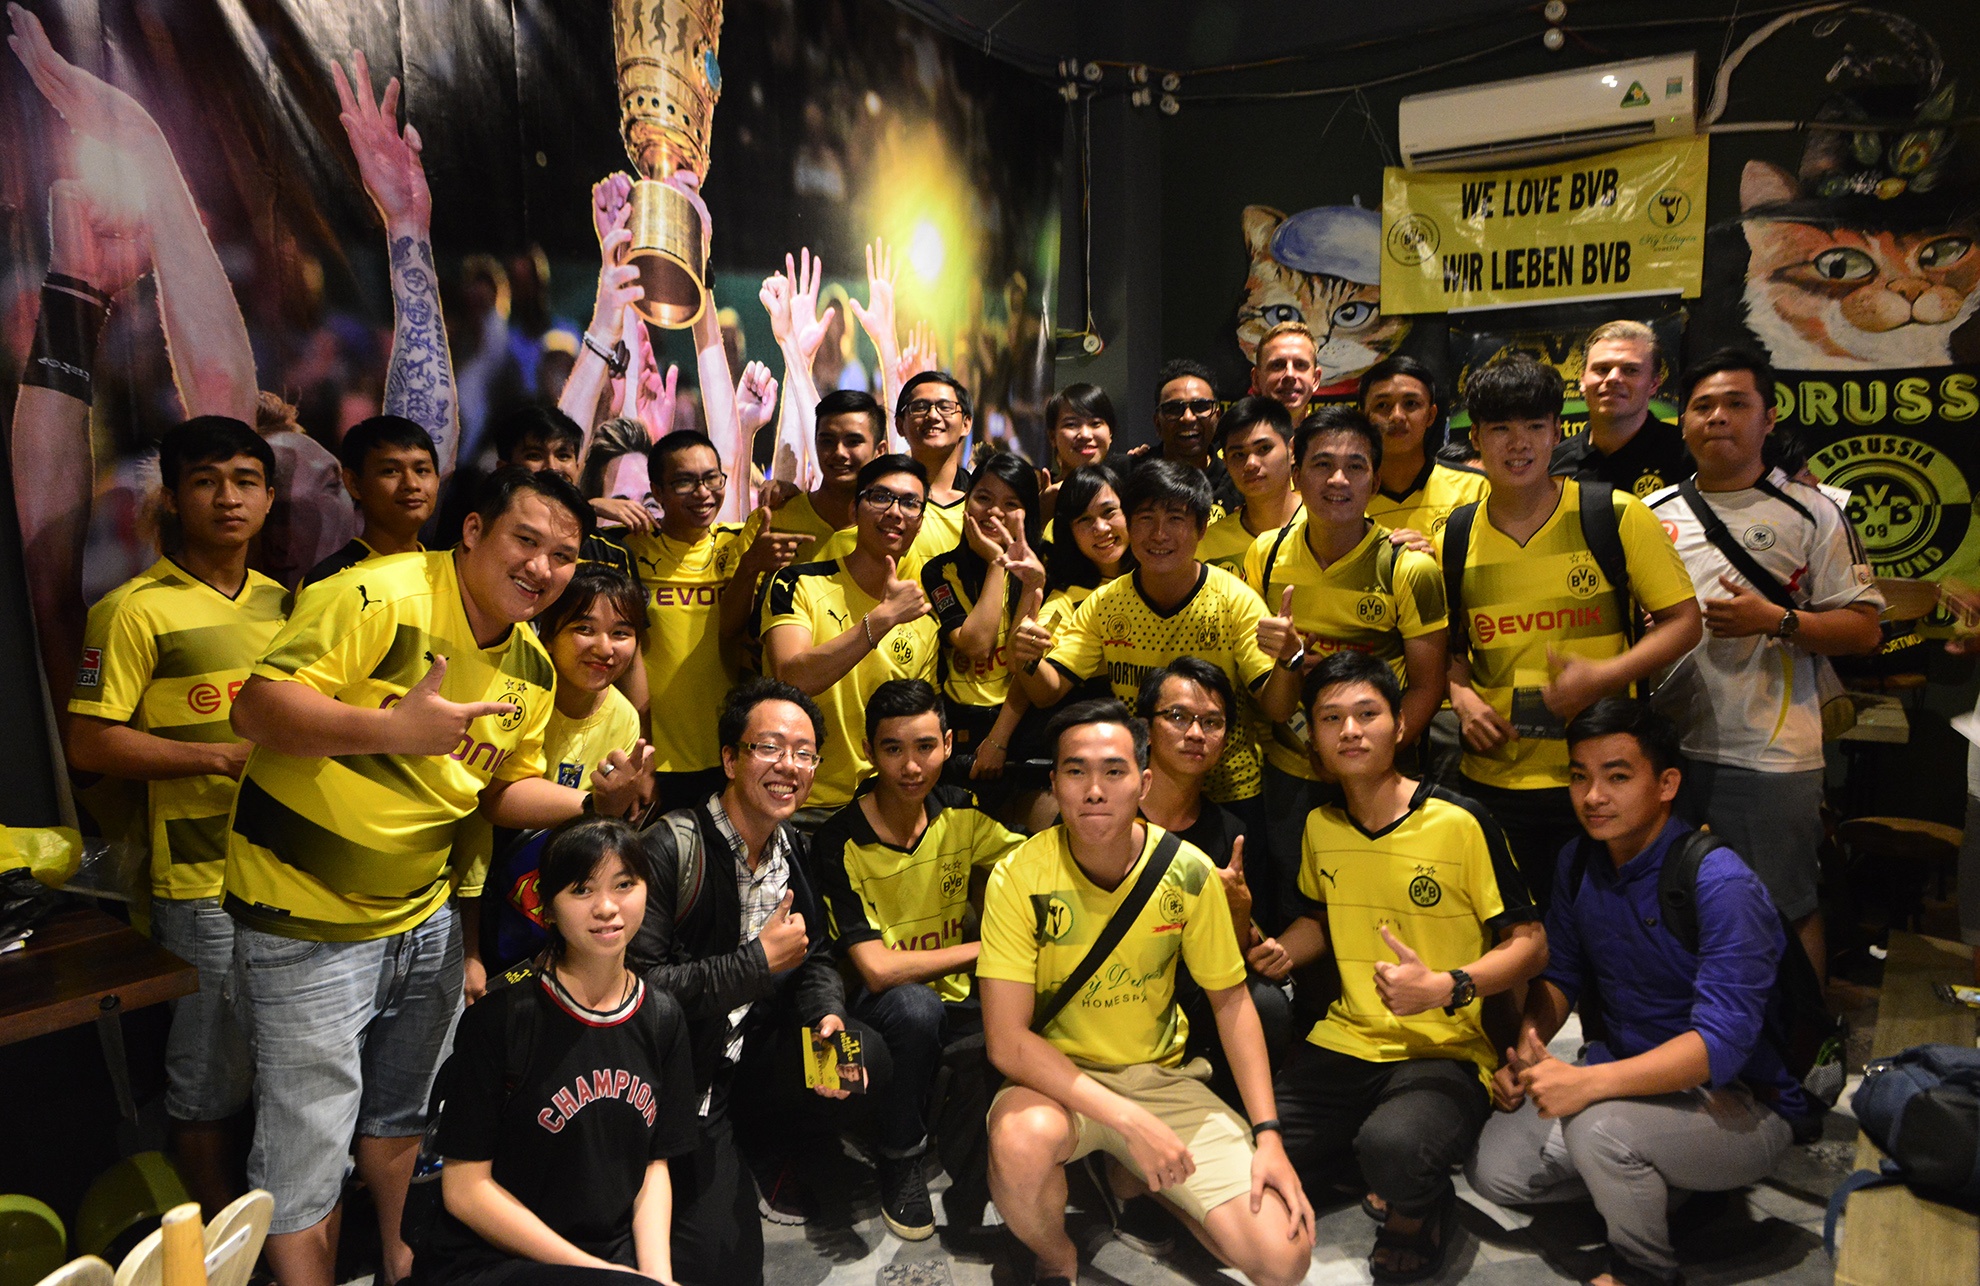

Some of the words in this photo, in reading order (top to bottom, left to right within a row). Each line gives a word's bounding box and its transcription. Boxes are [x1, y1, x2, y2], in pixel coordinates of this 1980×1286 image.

[1461, 181, 1496, 220] WE
[1503, 173, 1562, 218] LOVE
[1569, 168, 1619, 211] BVB
[1442, 252, 1483, 292] WIR
[1491, 245, 1573, 291] LIEBEN
[1582, 241, 1631, 285] BVB
[1817, 437, 1937, 469] BORUSSIA
[1865, 523, 1888, 538] 09
[1571, 568, 1597, 587] BVB
[656, 586, 726, 606] EVO
[1360, 599, 1382, 615] BVB
[894, 640, 912, 658] BVB
[502, 718, 512, 727] 09
[943, 874, 963, 893] BVB
[1414, 880, 1437, 899] BVB
[537, 1068, 658, 1134] CHAMPION
